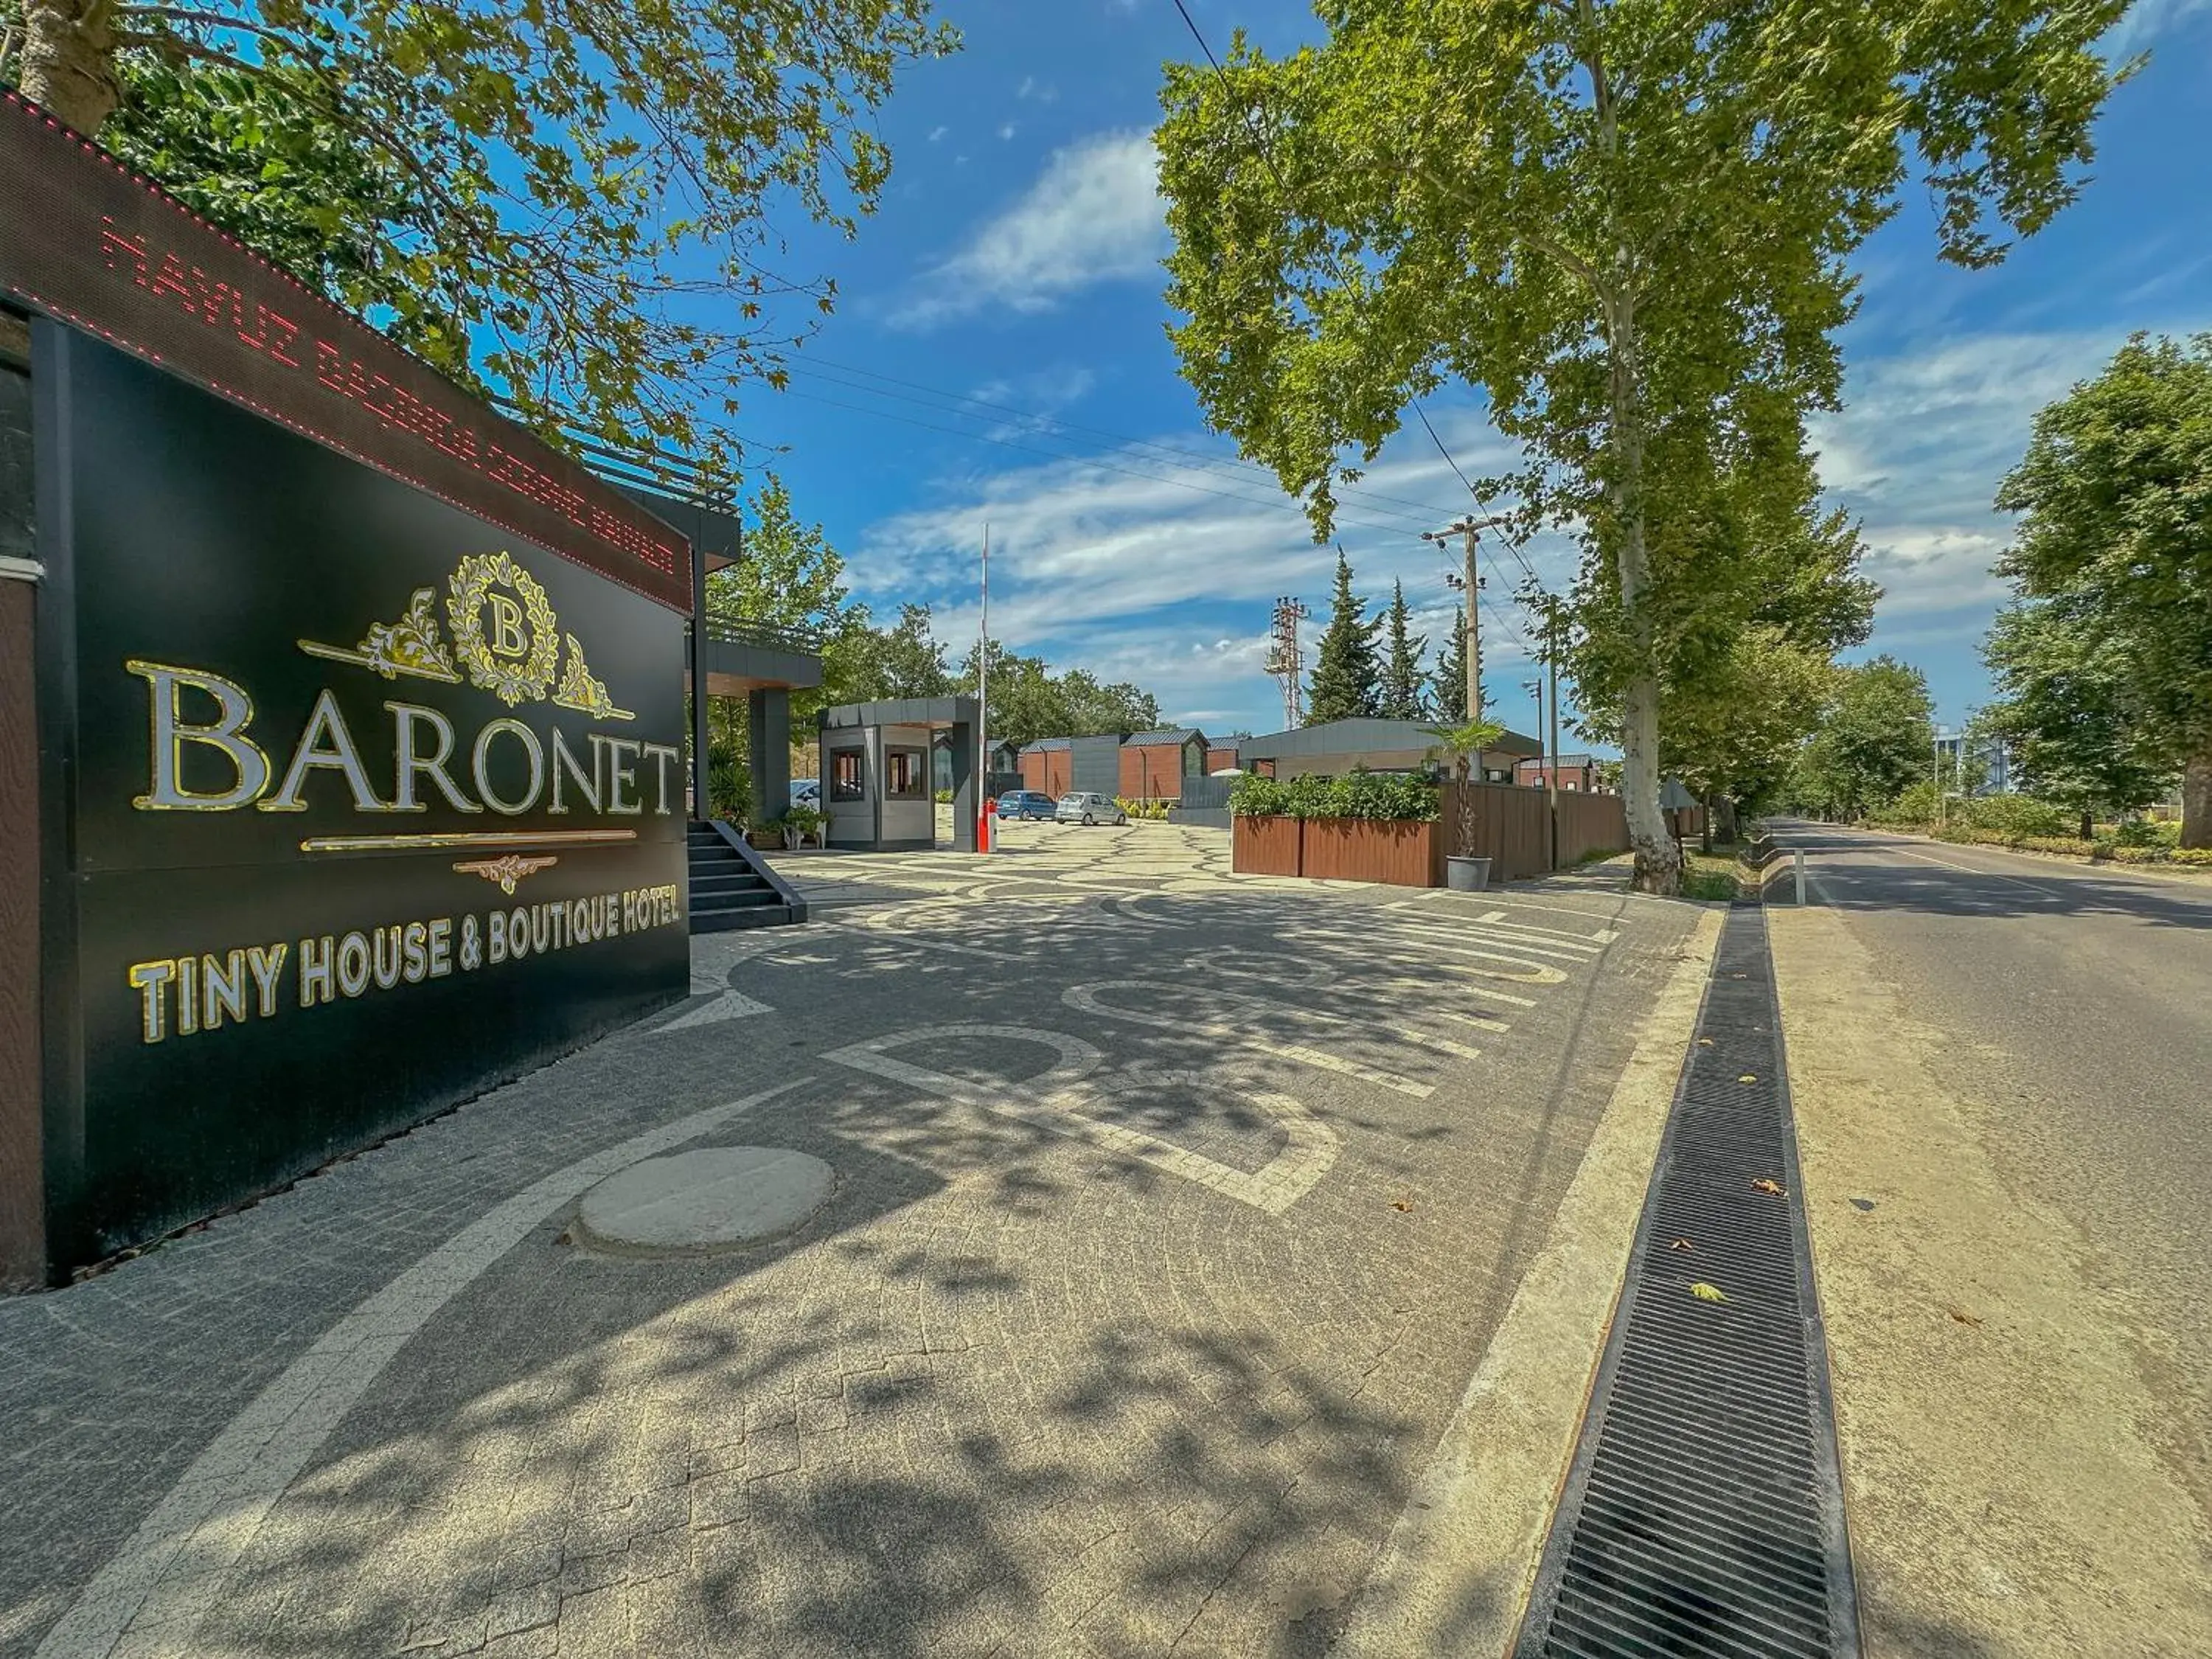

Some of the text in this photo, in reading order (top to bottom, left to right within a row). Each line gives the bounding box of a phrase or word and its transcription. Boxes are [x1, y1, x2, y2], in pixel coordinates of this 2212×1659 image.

[490, 593, 527, 655] B
[126, 661, 680, 815] BARONET
[129, 884, 681, 1044] TINY HOUSE & BOUTIQUE HOTEL
